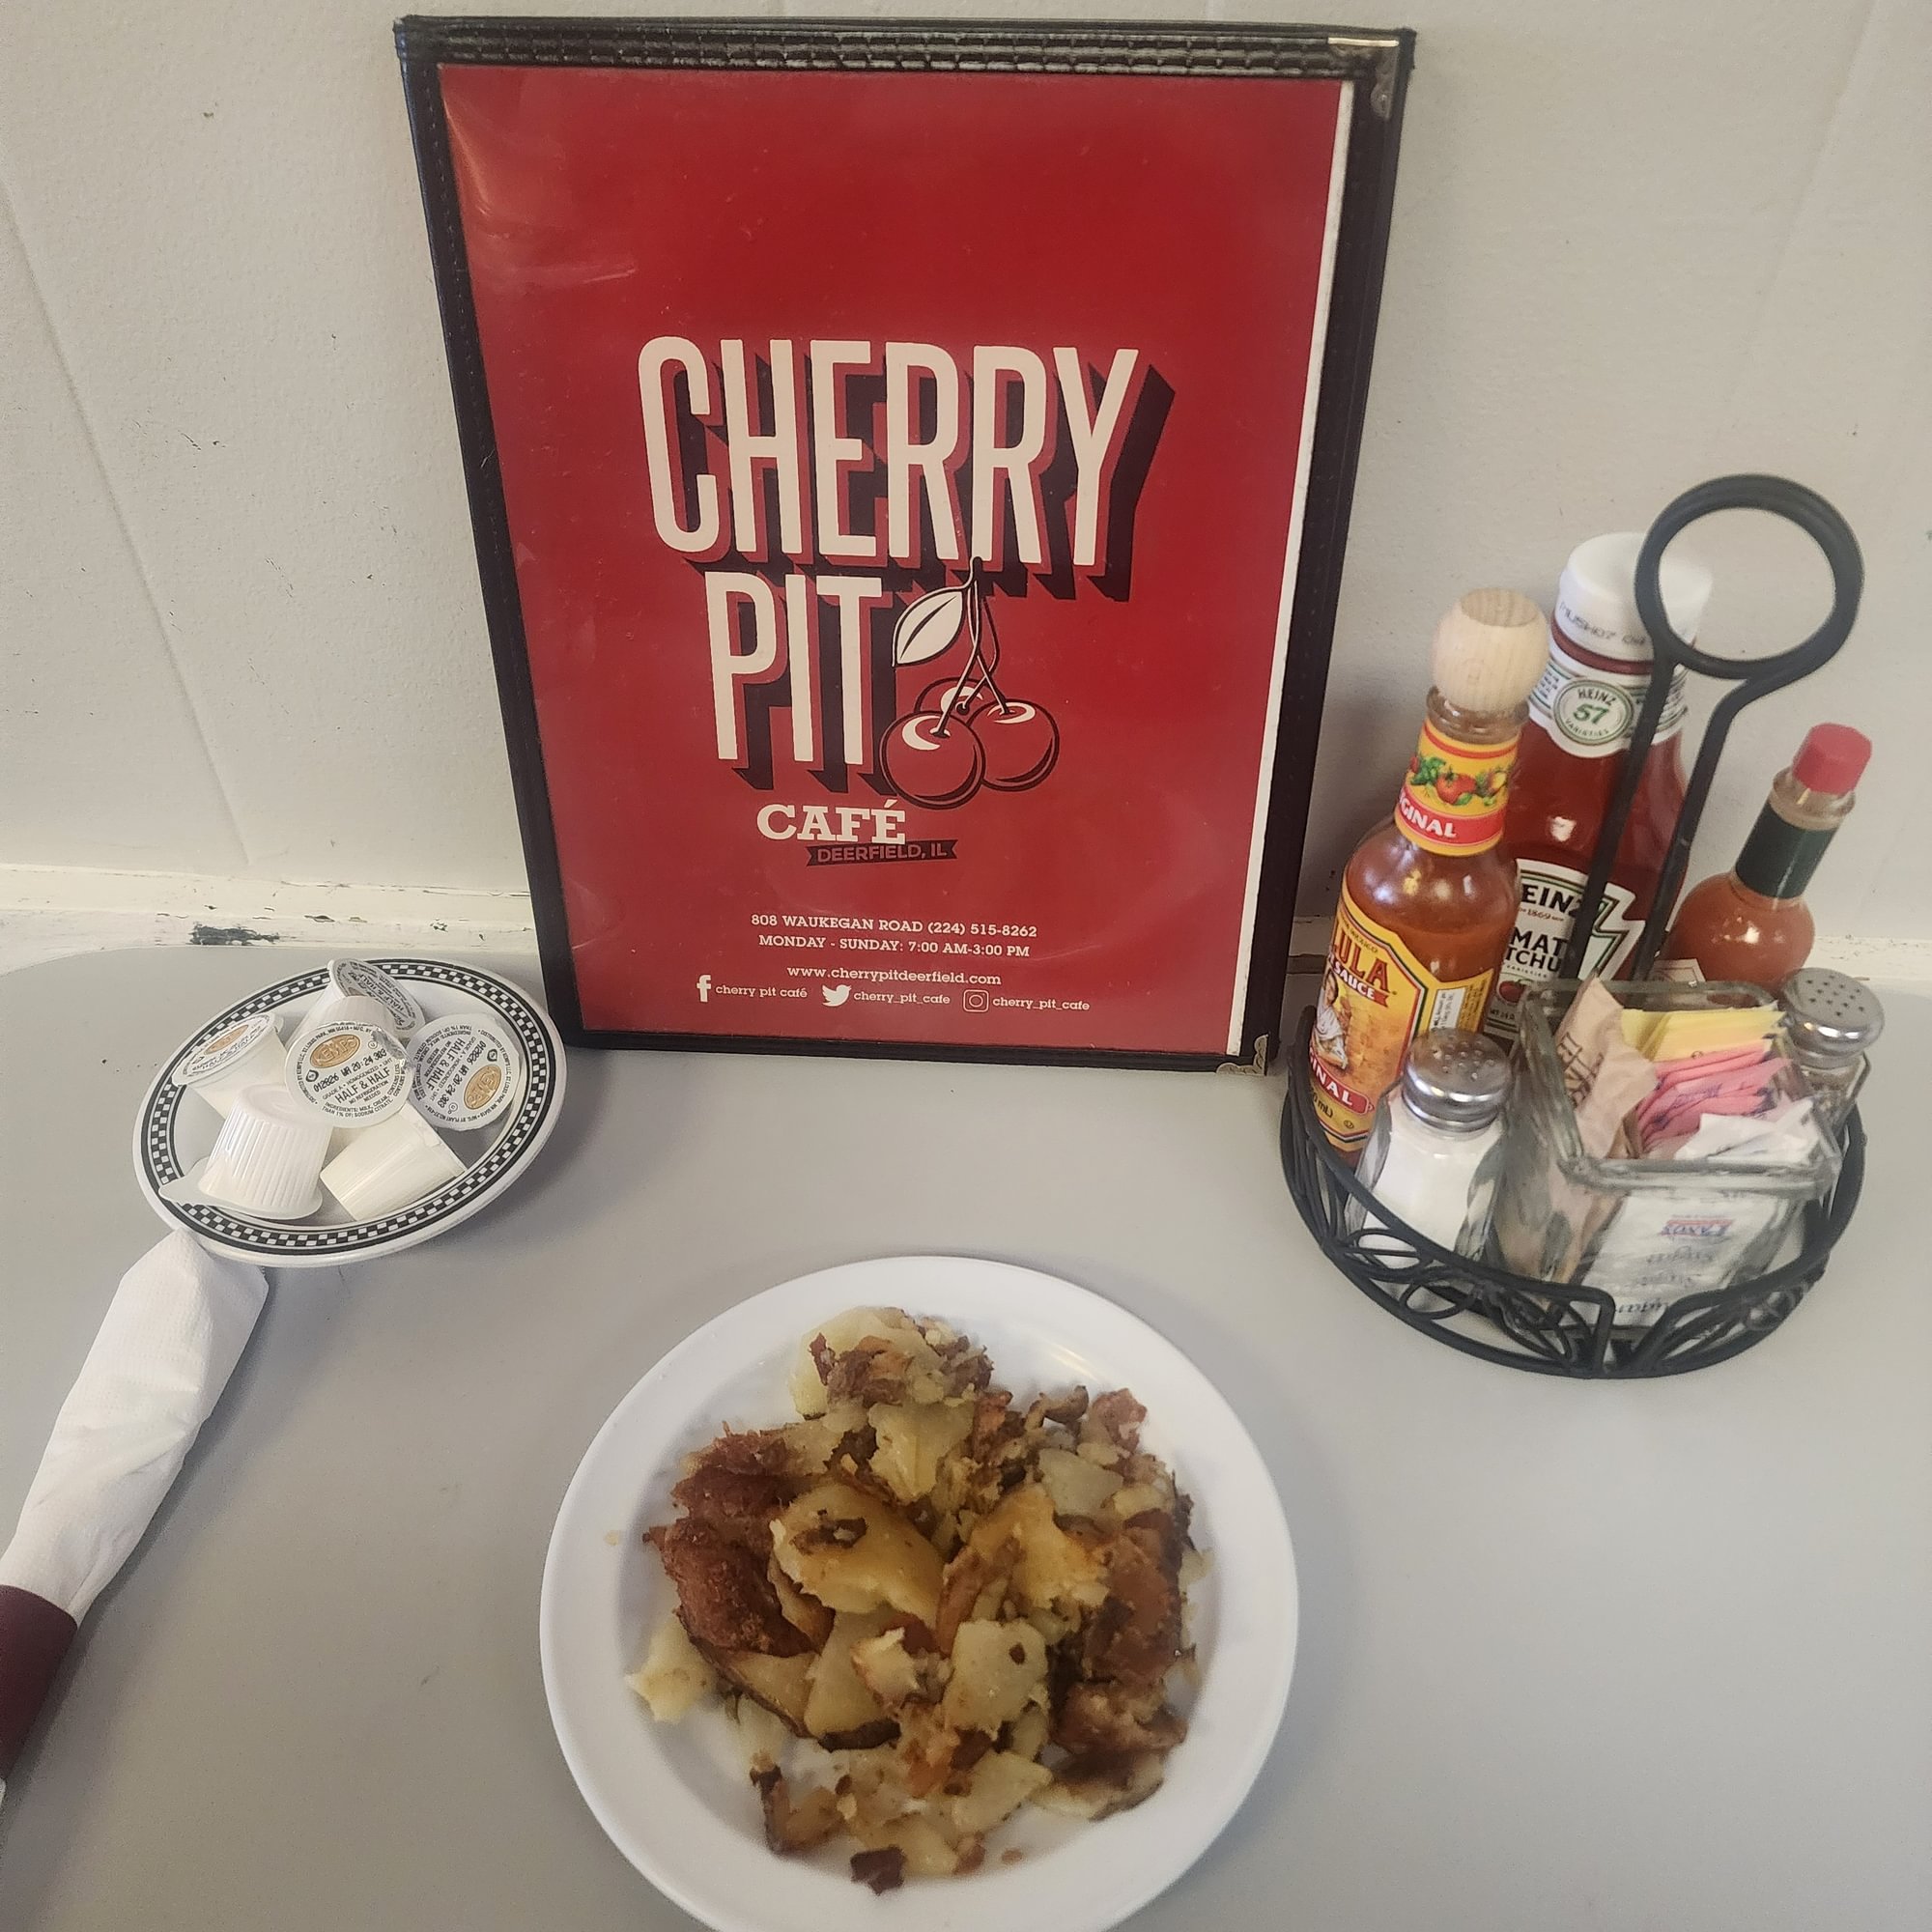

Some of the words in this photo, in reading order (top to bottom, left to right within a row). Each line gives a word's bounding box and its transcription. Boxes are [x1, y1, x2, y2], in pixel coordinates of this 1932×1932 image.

[639, 335, 1140, 567] CHERRY
[704, 571, 883, 766] PIT
[1577, 688, 1617, 707] HEINZ
[1573, 703, 1609, 724] 57
[757, 799, 906, 845] CAFÉ
[816, 842, 928, 863] DEERFIELD,
[930, 841, 948, 858] IL
[1520, 883, 1582, 917] EIN
[751, 914, 779, 927] 808
[781, 915, 874, 931] WAUKEGAN
[878, 919, 923, 933] ROAD
[927, 920, 966, 936] (224)
[970, 922, 1037, 938] 515-8262
[758, 934, 826, 950] MONDAY
[838, 937, 903, 952] SUNDAY:
[908, 940, 939, 954] 7:00
[942, 942, 1004, 957] AM-3:00
[1007, 944, 1031, 958] PM
[1510, 926, 1570, 957] MAT
[1505, 945, 1562, 973] TCHU
[787, 965, 1002, 986] www.cherrypitdeerfield.com
[1335, 960, 1376, 1000] SAUCE
[715, 983, 757, 1000] cherry
[759, 983, 777, 999] pit
[779, 985, 808, 1000] café
[853, 989, 951, 1007] cherry_pit_cafe
[992, 995, 1091, 1012] cherry_pit_cafe
[314, 1035, 358, 1065] KEMPS
[446, 1037, 466, 1062] HALF
[439, 1059, 449, 1067] &
[335, 1084, 359, 1103] HALF
[360, 1080, 369, 1090] &
[369, 1066, 391, 1086] HALF
[426, 1066, 445, 1092] HALF
